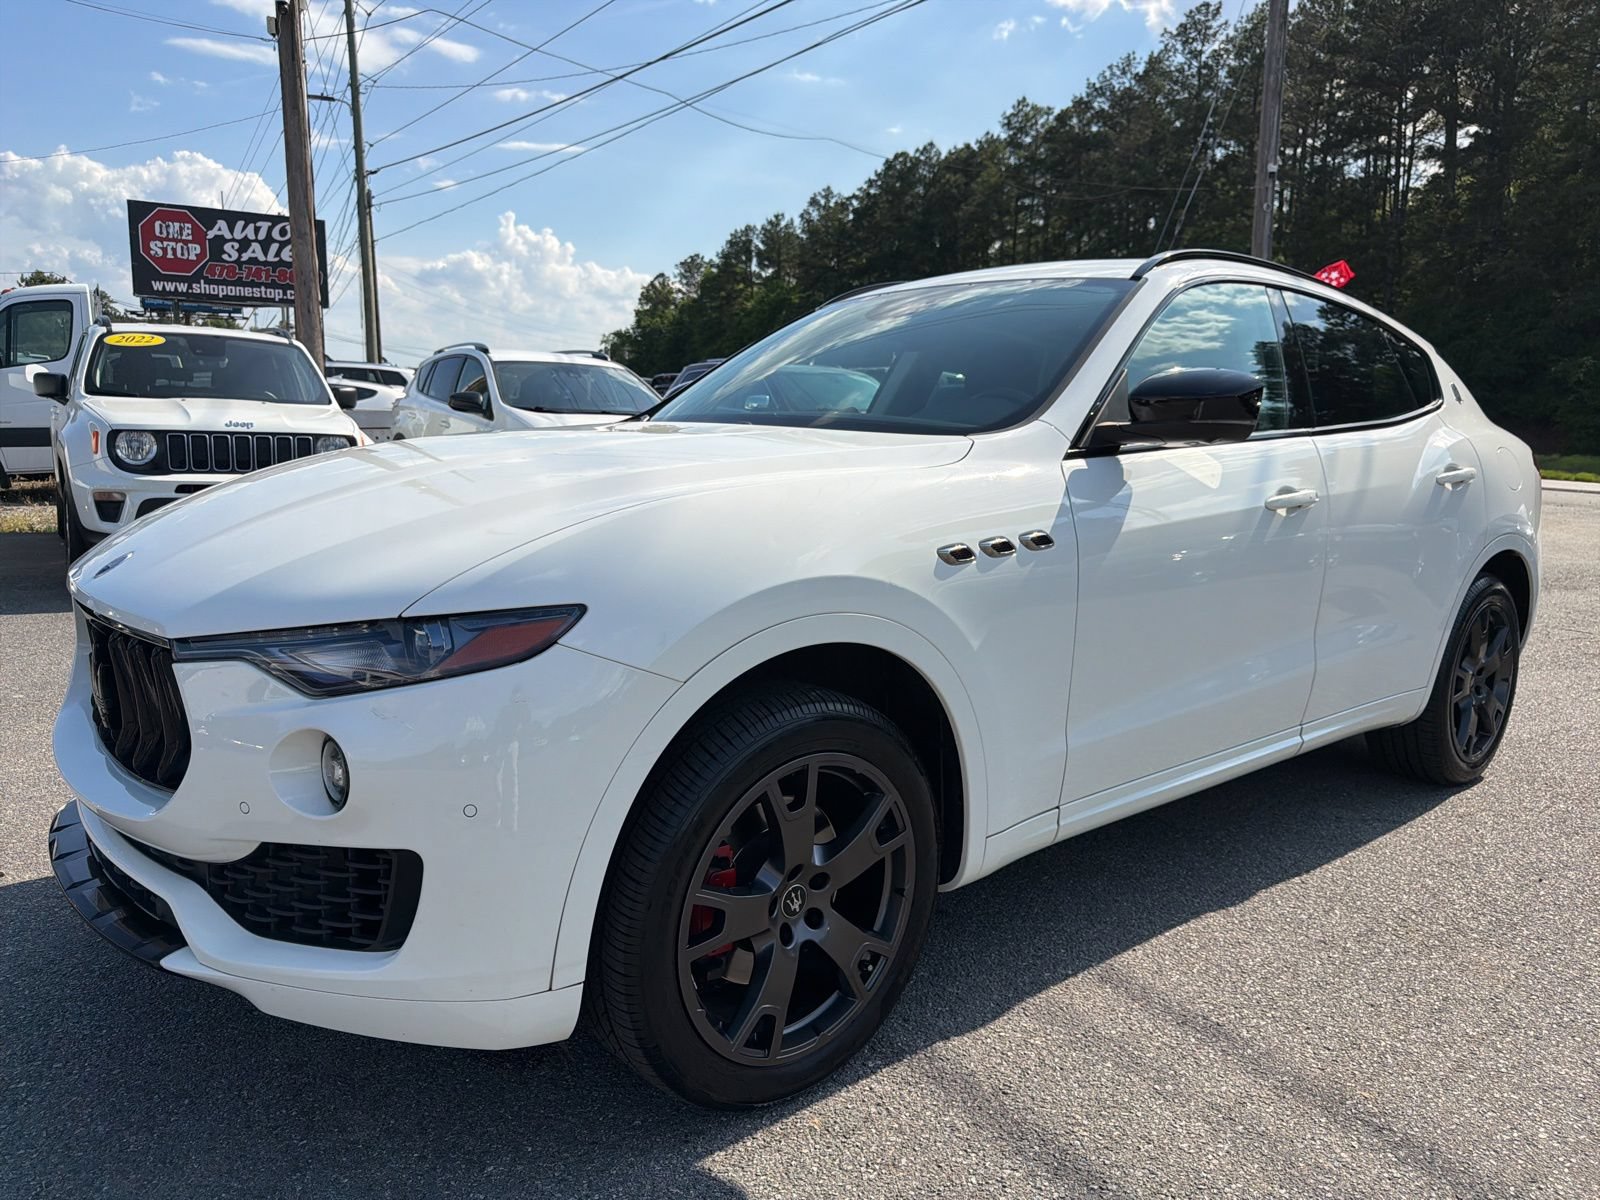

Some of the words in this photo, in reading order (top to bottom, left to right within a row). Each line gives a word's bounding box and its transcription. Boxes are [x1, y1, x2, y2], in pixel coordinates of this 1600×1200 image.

[154, 220, 192, 240] ONE
[205, 219, 291, 241] AUTO
[149, 240, 201, 261] STOP
[221, 241, 293, 262] SALE
[151, 279, 295, 301] www.shoponestop.c
[115, 335, 155, 343] 2022
[224, 420, 254, 430] Jeep
